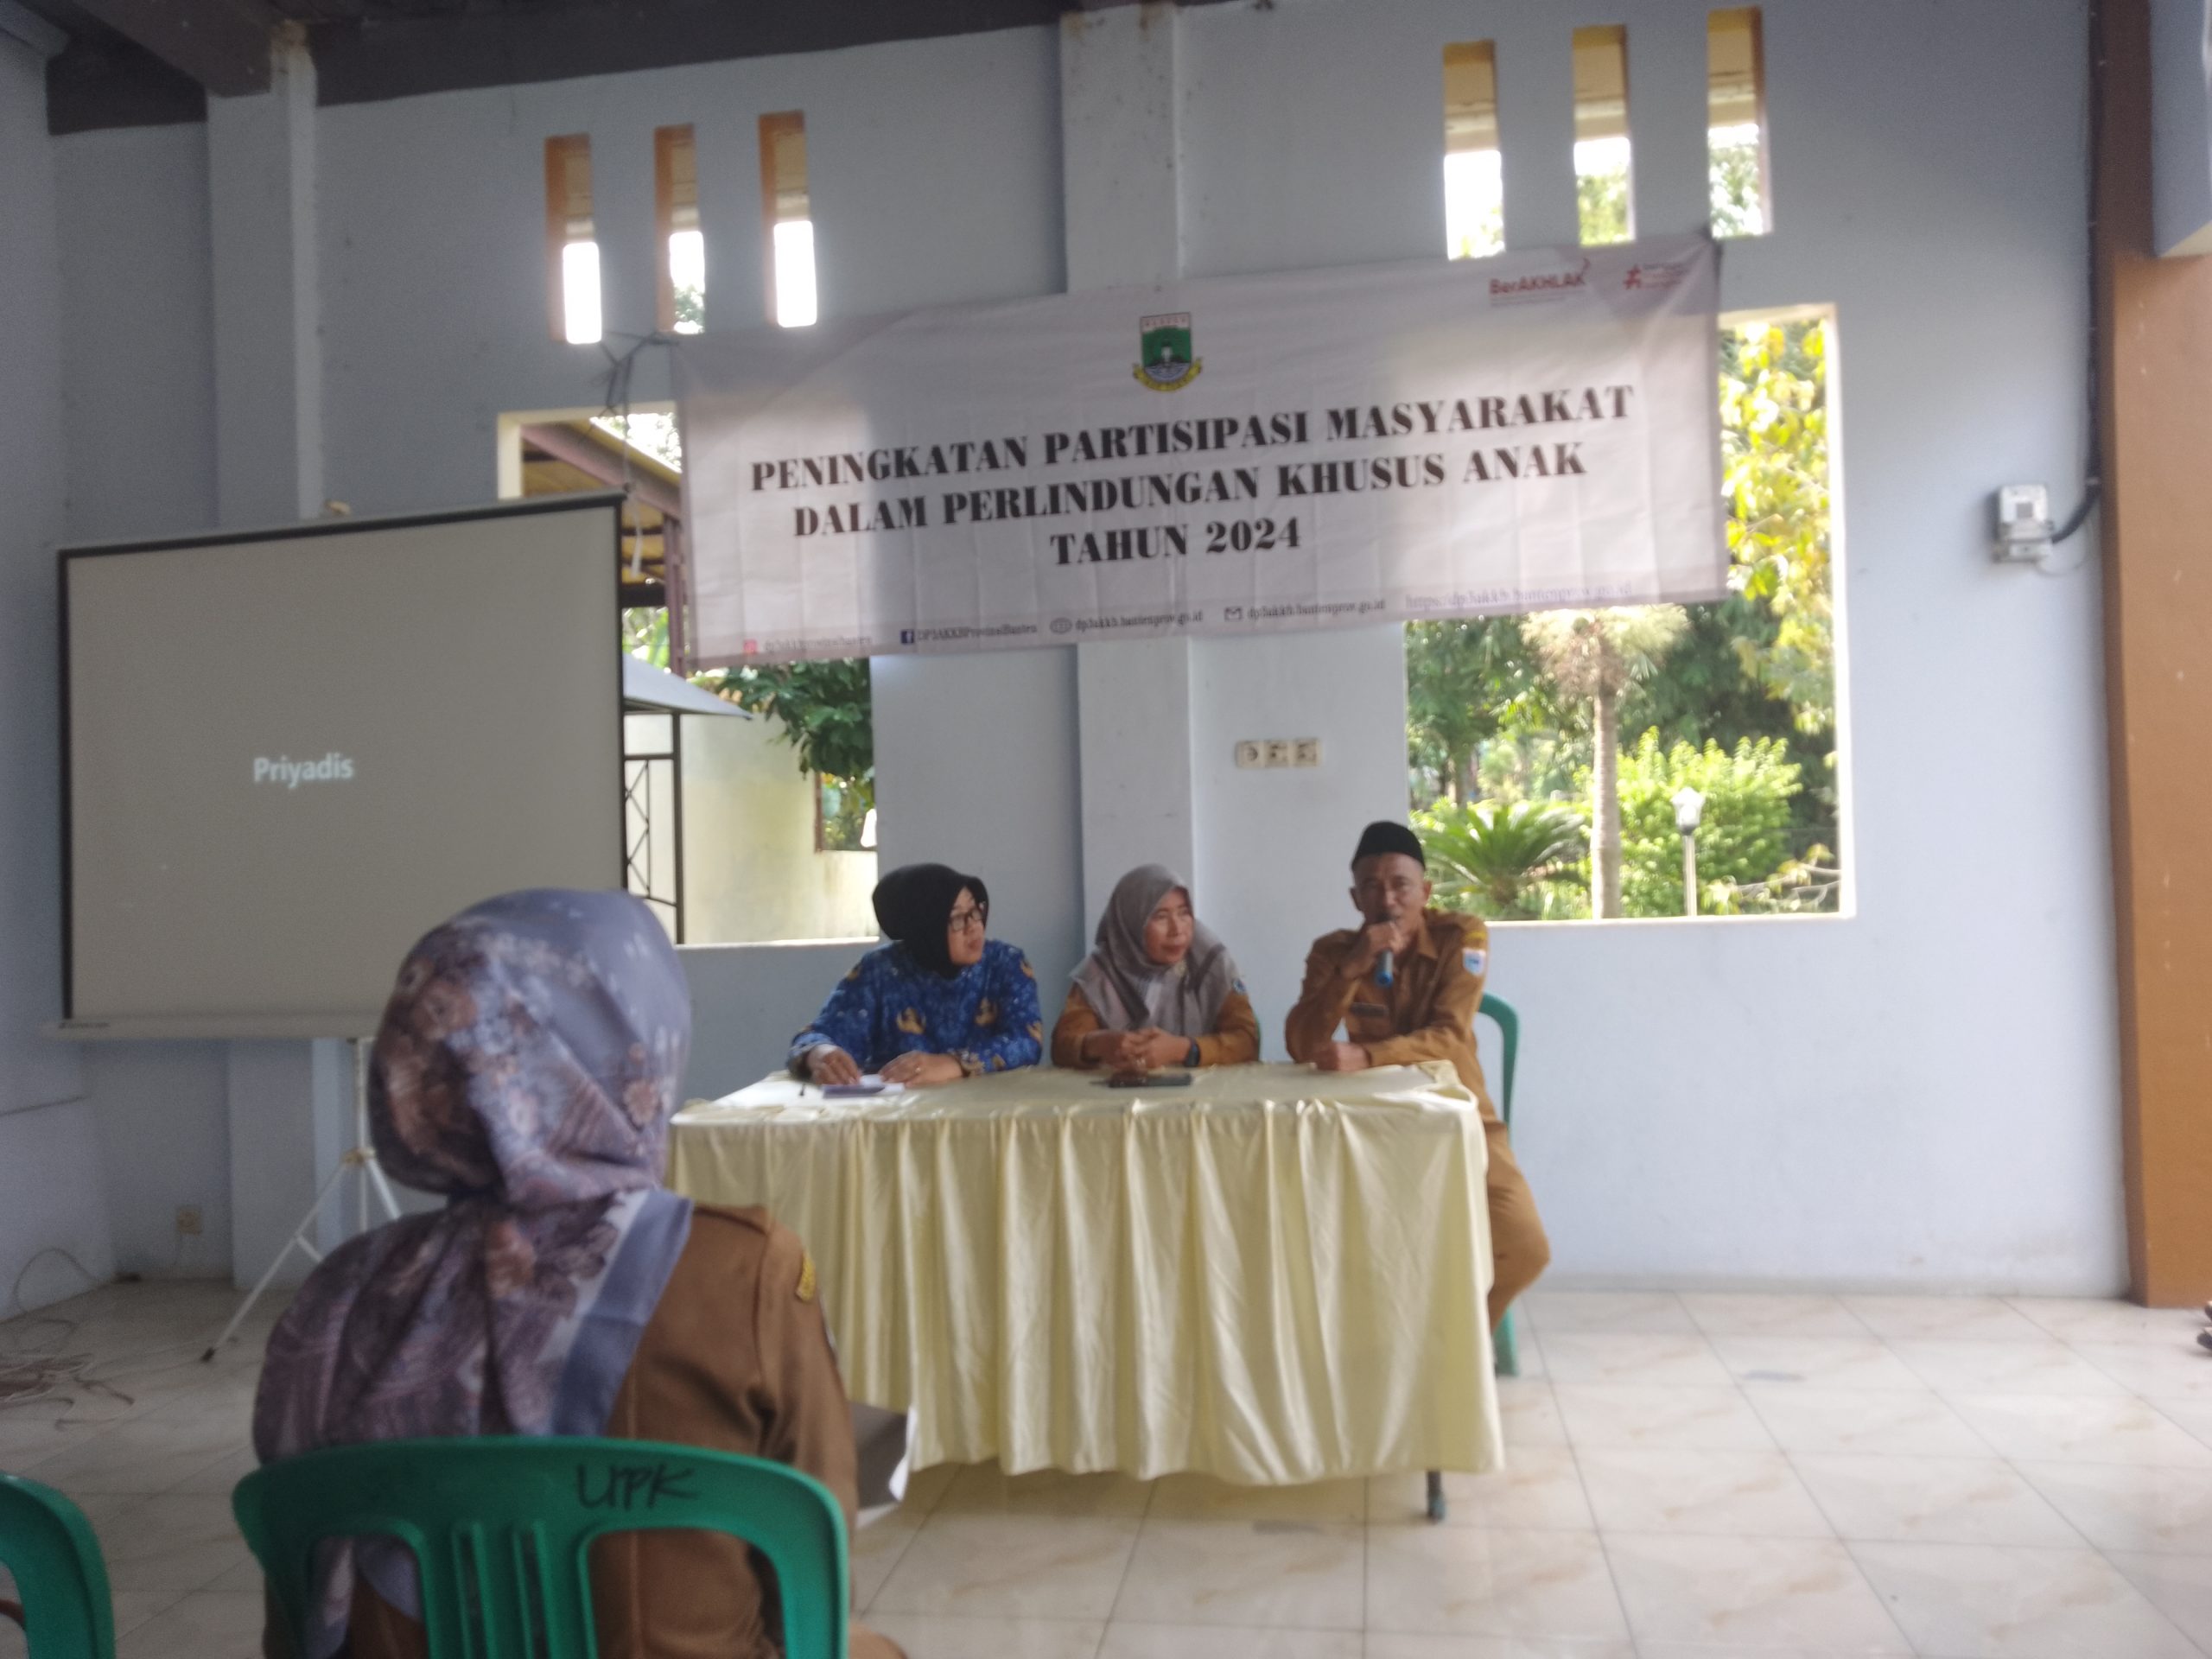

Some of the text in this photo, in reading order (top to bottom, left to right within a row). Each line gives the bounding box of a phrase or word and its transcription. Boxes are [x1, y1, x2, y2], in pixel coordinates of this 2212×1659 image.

[1490, 268, 1587, 295] BerAKHLAK
[751, 385, 1634, 492] PENINGKATAN PARTISIPASI MASYARAKAT
[794, 442, 1587, 537] DALAM PERLINDUNGAN KHUSUS ANAK
[1050, 517, 1300, 565] TAHUN 2024
[253, 752, 353, 788] Priyadis
[576, 1463, 697, 1510] UPK
